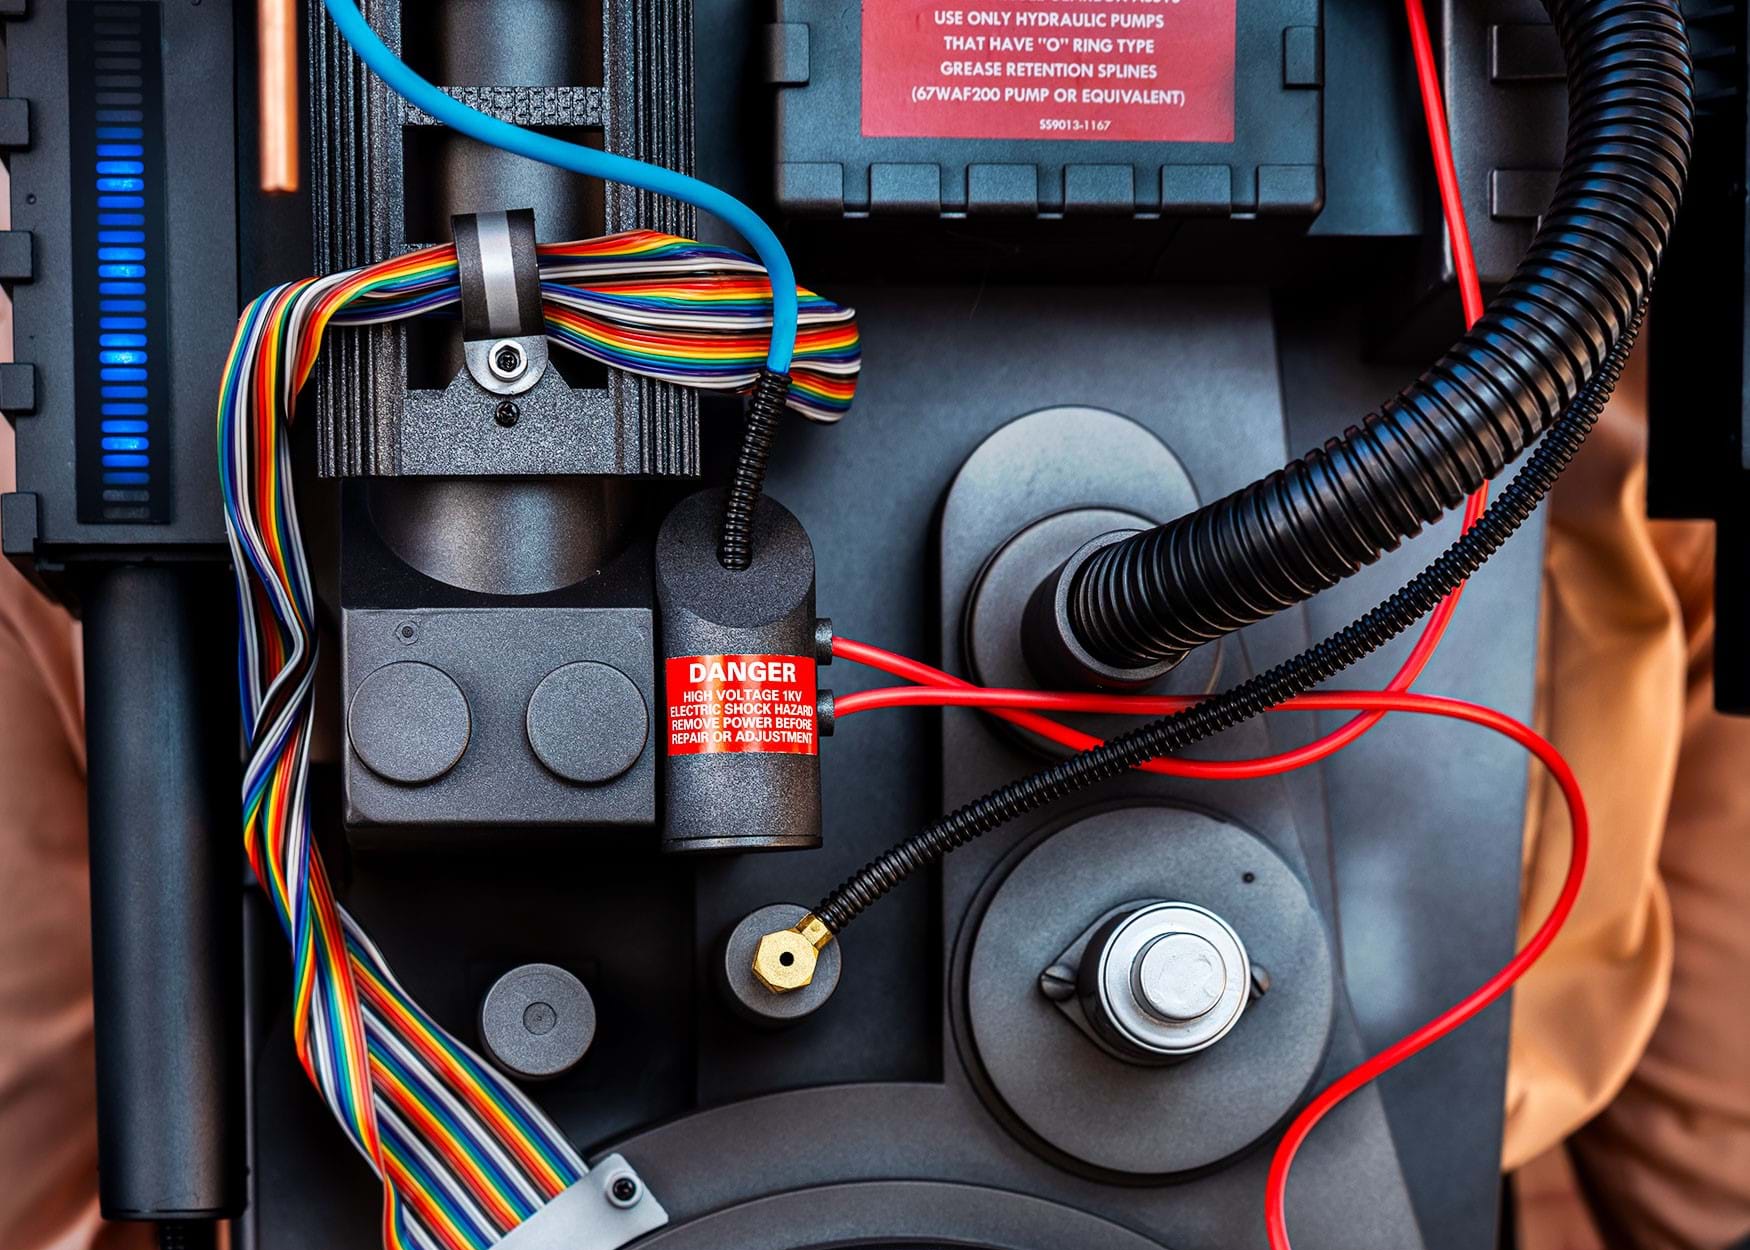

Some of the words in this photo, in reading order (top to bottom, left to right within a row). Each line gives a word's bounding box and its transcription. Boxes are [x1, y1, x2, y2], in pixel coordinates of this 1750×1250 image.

[934, 11, 963, 26] USE
[967, 11, 1011, 26] ONLY
[1015, 12, 1107, 28] HYDRAULIC
[1110, 13, 1164, 28] PUMPS
[943, 36, 985, 51] THAT
[989, 37, 1034, 52] HAVE
[1038, 37, 1069, 53] "O"
[1073, 38, 1113, 53] RING
[1116, 39, 1155, 54] TYPE
[940, 61, 1002, 77] GREASE
[1006, 62, 1094, 78] RETENTION
[1097, 64, 1157, 79] SPLINES
[911, 86, 1001, 103] (67WAF200
[1004, 88, 1049, 103] PUMP
[1053, 89, 1077, 104] OR
[1081, 89, 1185, 106] EQUIVALENT)
[690, 661, 796, 683] DANGER
[684, 690, 712, 702] HIGH
[716, 689, 780, 701] VOLTAGE
[783, 690, 802, 702] 1KV
[670, 703, 721, 717] ELECTRIC
[724, 703, 771, 715] SHOCK
[775, 703, 813, 717] HAZARD
[672, 717, 721, 731] REMOVE
[723, 716, 772, 729] POWER
[775, 718, 813, 730] BEFORE
[672, 731, 710, 745] REPAIR
[713, 730, 732, 743] OR
[735, 730, 813, 744] ADJUSTMENT
